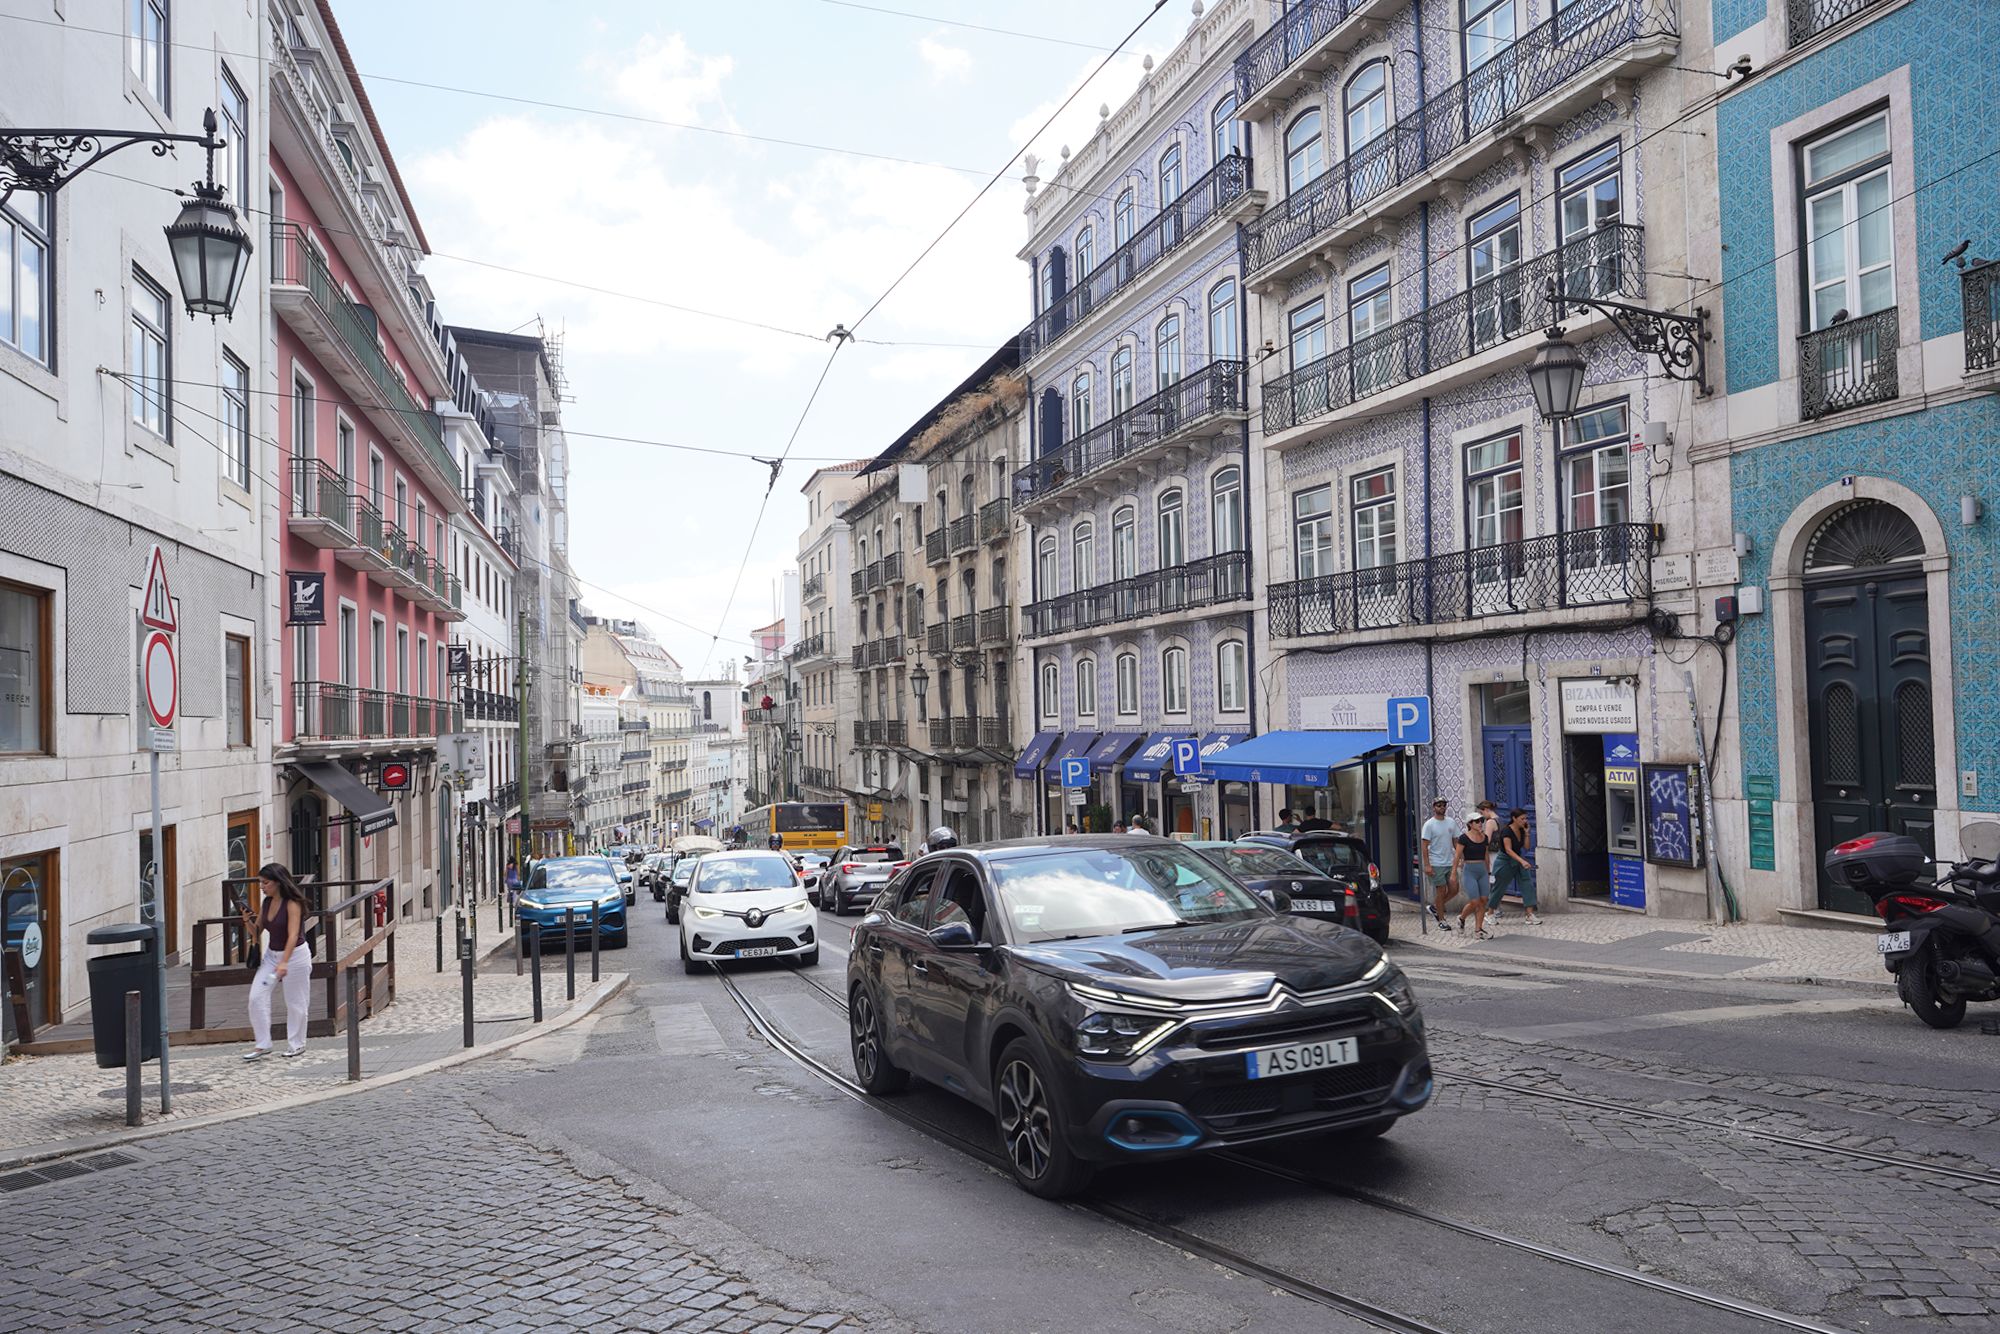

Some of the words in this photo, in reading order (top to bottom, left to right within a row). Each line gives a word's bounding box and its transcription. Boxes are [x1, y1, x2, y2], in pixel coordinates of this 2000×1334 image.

[1565, 687, 1632, 701] BIZANTINA
[1603, 704, 1622, 712] VENDE
[1331, 712, 1358, 726] XVIII
[1396, 703, 1419, 739] P
[1568, 717, 1587, 725] LIVROS
[1587, 717, 1605, 725] NOVOS
[1610, 716, 1632, 724] USADOS
[1177, 742, 1194, 772] P
[1067, 762, 1083, 785] P
[1608, 771, 1635, 782] ATM
[1888, 933, 1900, 942] 78
[742, 947, 774, 957] CE63AJ
[1267, 1040, 1349, 1074] AS09LT
